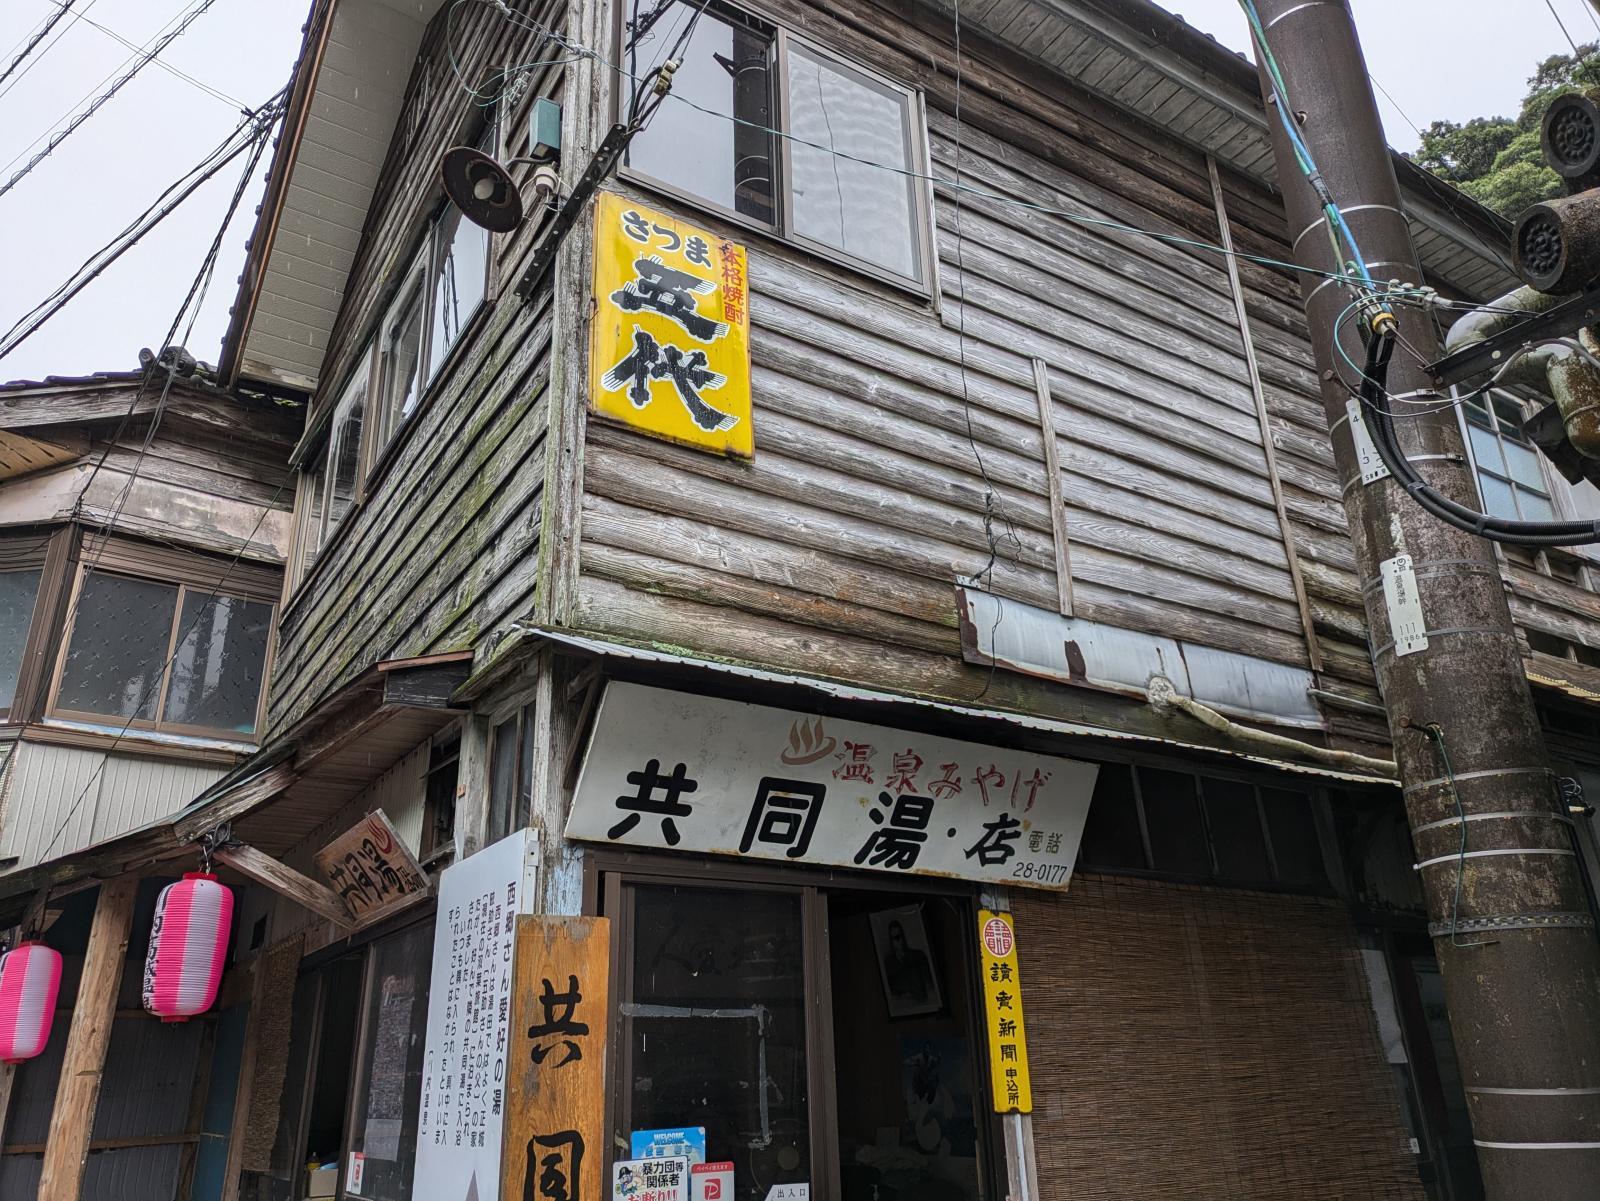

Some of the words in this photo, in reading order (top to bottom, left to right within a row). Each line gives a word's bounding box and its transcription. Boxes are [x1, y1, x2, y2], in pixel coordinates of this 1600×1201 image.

[621, 210, 712, 267] さつま
[719, 241, 745, 326] 本格焼酎
[601, 253, 740, 432] 五代
[832, 739, 1053, 812] 温泉みやげ
[1028, 830, 1061, 855] 電話
[1012, 862, 1068, 884] 28-0177
[491, 881, 517, 1115] 西郷さん愛好の湯
[642, 1160, 684, 1175] 暴力団等
[646, 1173, 680, 1188] 関係者
[777, 1188, 806, 1198] 出入口
